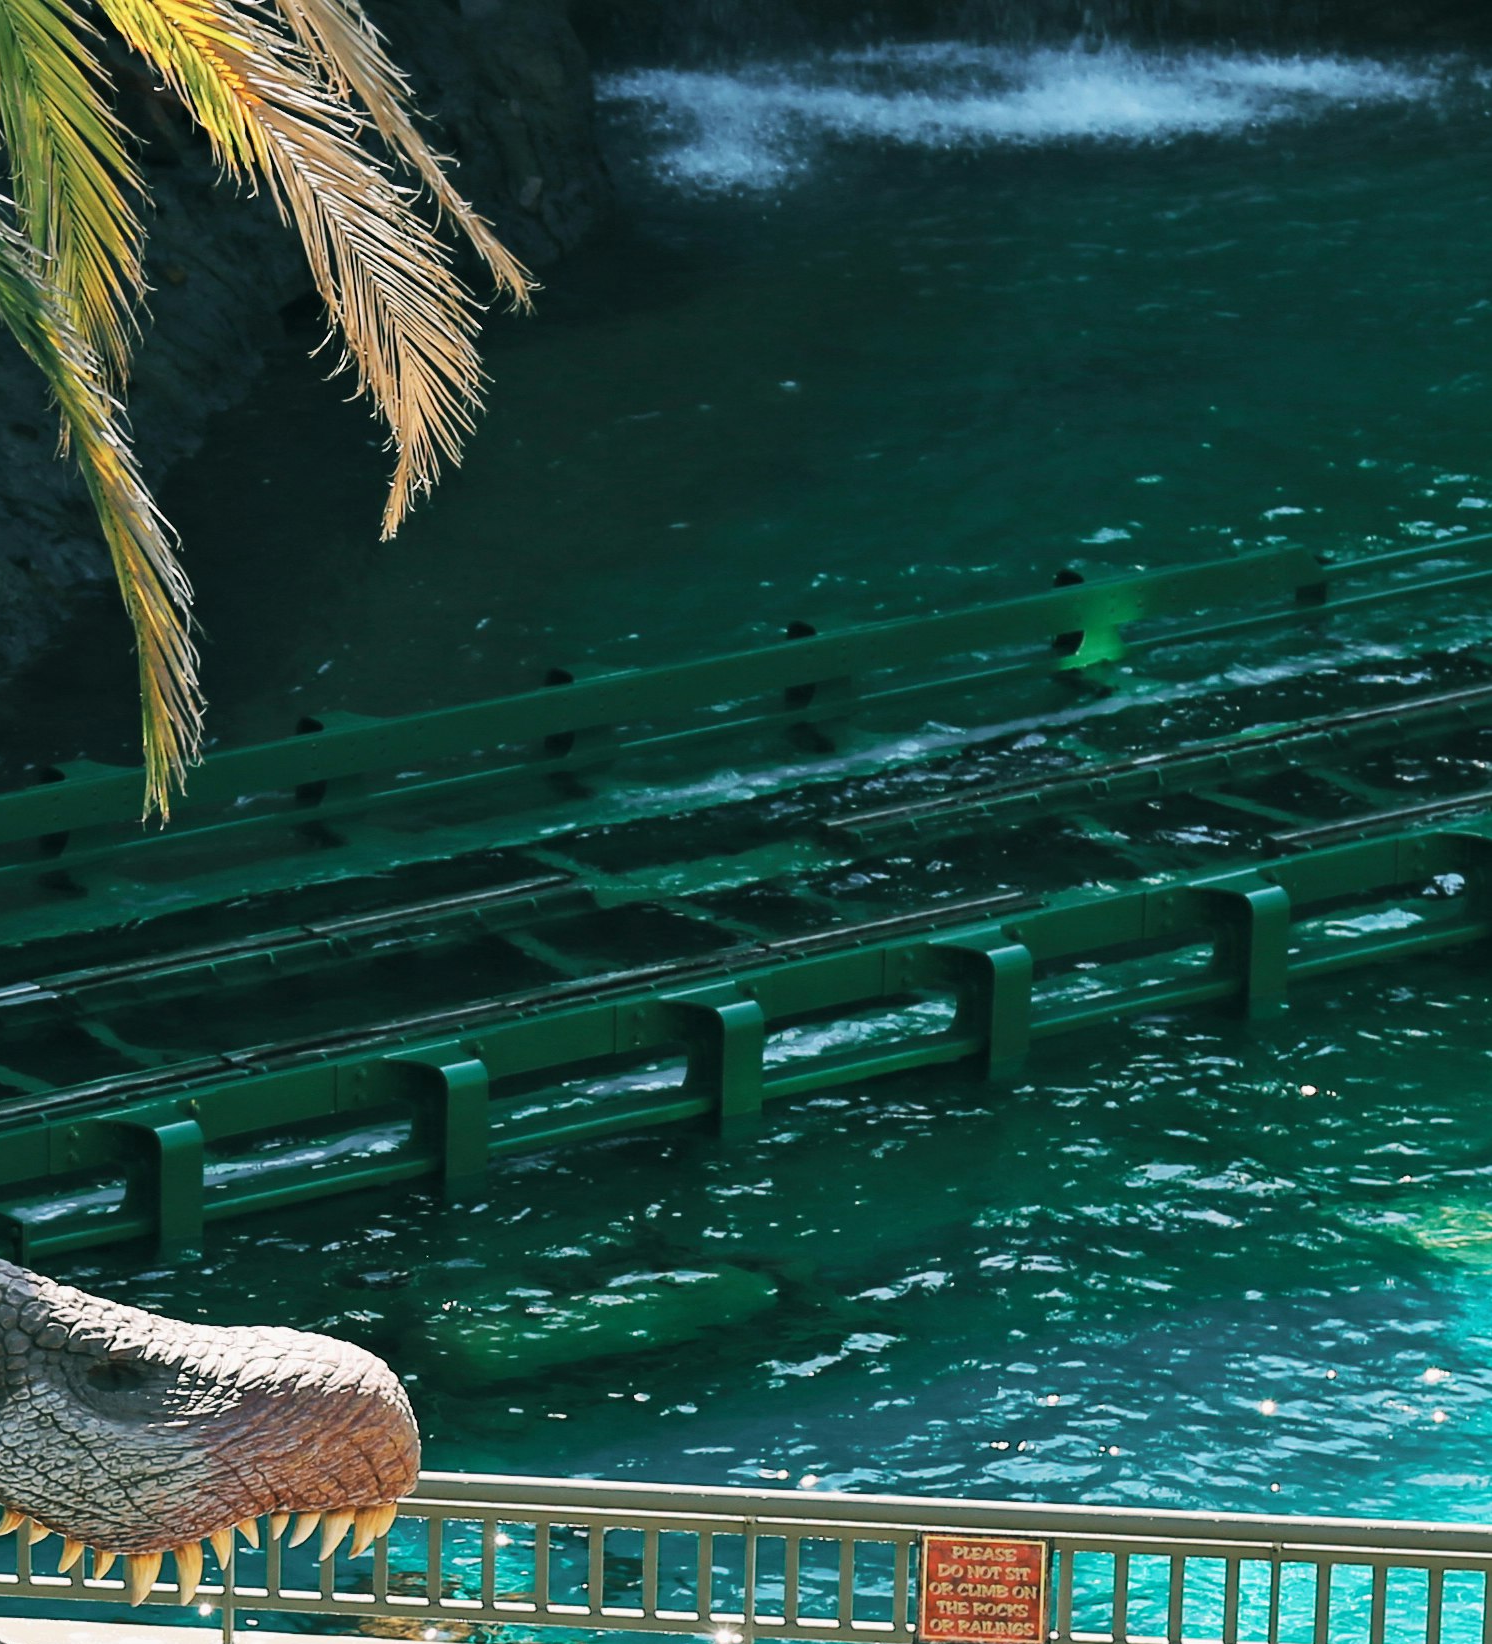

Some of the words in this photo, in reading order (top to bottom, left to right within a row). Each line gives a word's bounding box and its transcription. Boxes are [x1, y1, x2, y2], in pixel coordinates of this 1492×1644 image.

[952, 1546, 1017, 1562] PLEASE
[937, 1564, 963, 1578] DO
[967, 1565, 1003, 1579] NOT
[1005, 1567, 1031, 1581] SIT
[929, 1582, 953, 1595] OR
[957, 1584, 1008, 1598] CLIMB
[1012, 1586, 1037, 1599] ON
[936, 1600, 969, 1615] THE
[973, 1603, 1028, 1617] ROCKS
[930, 1619, 954, 1632] OR
[958, 1621, 1034, 1636] RAILINGS
